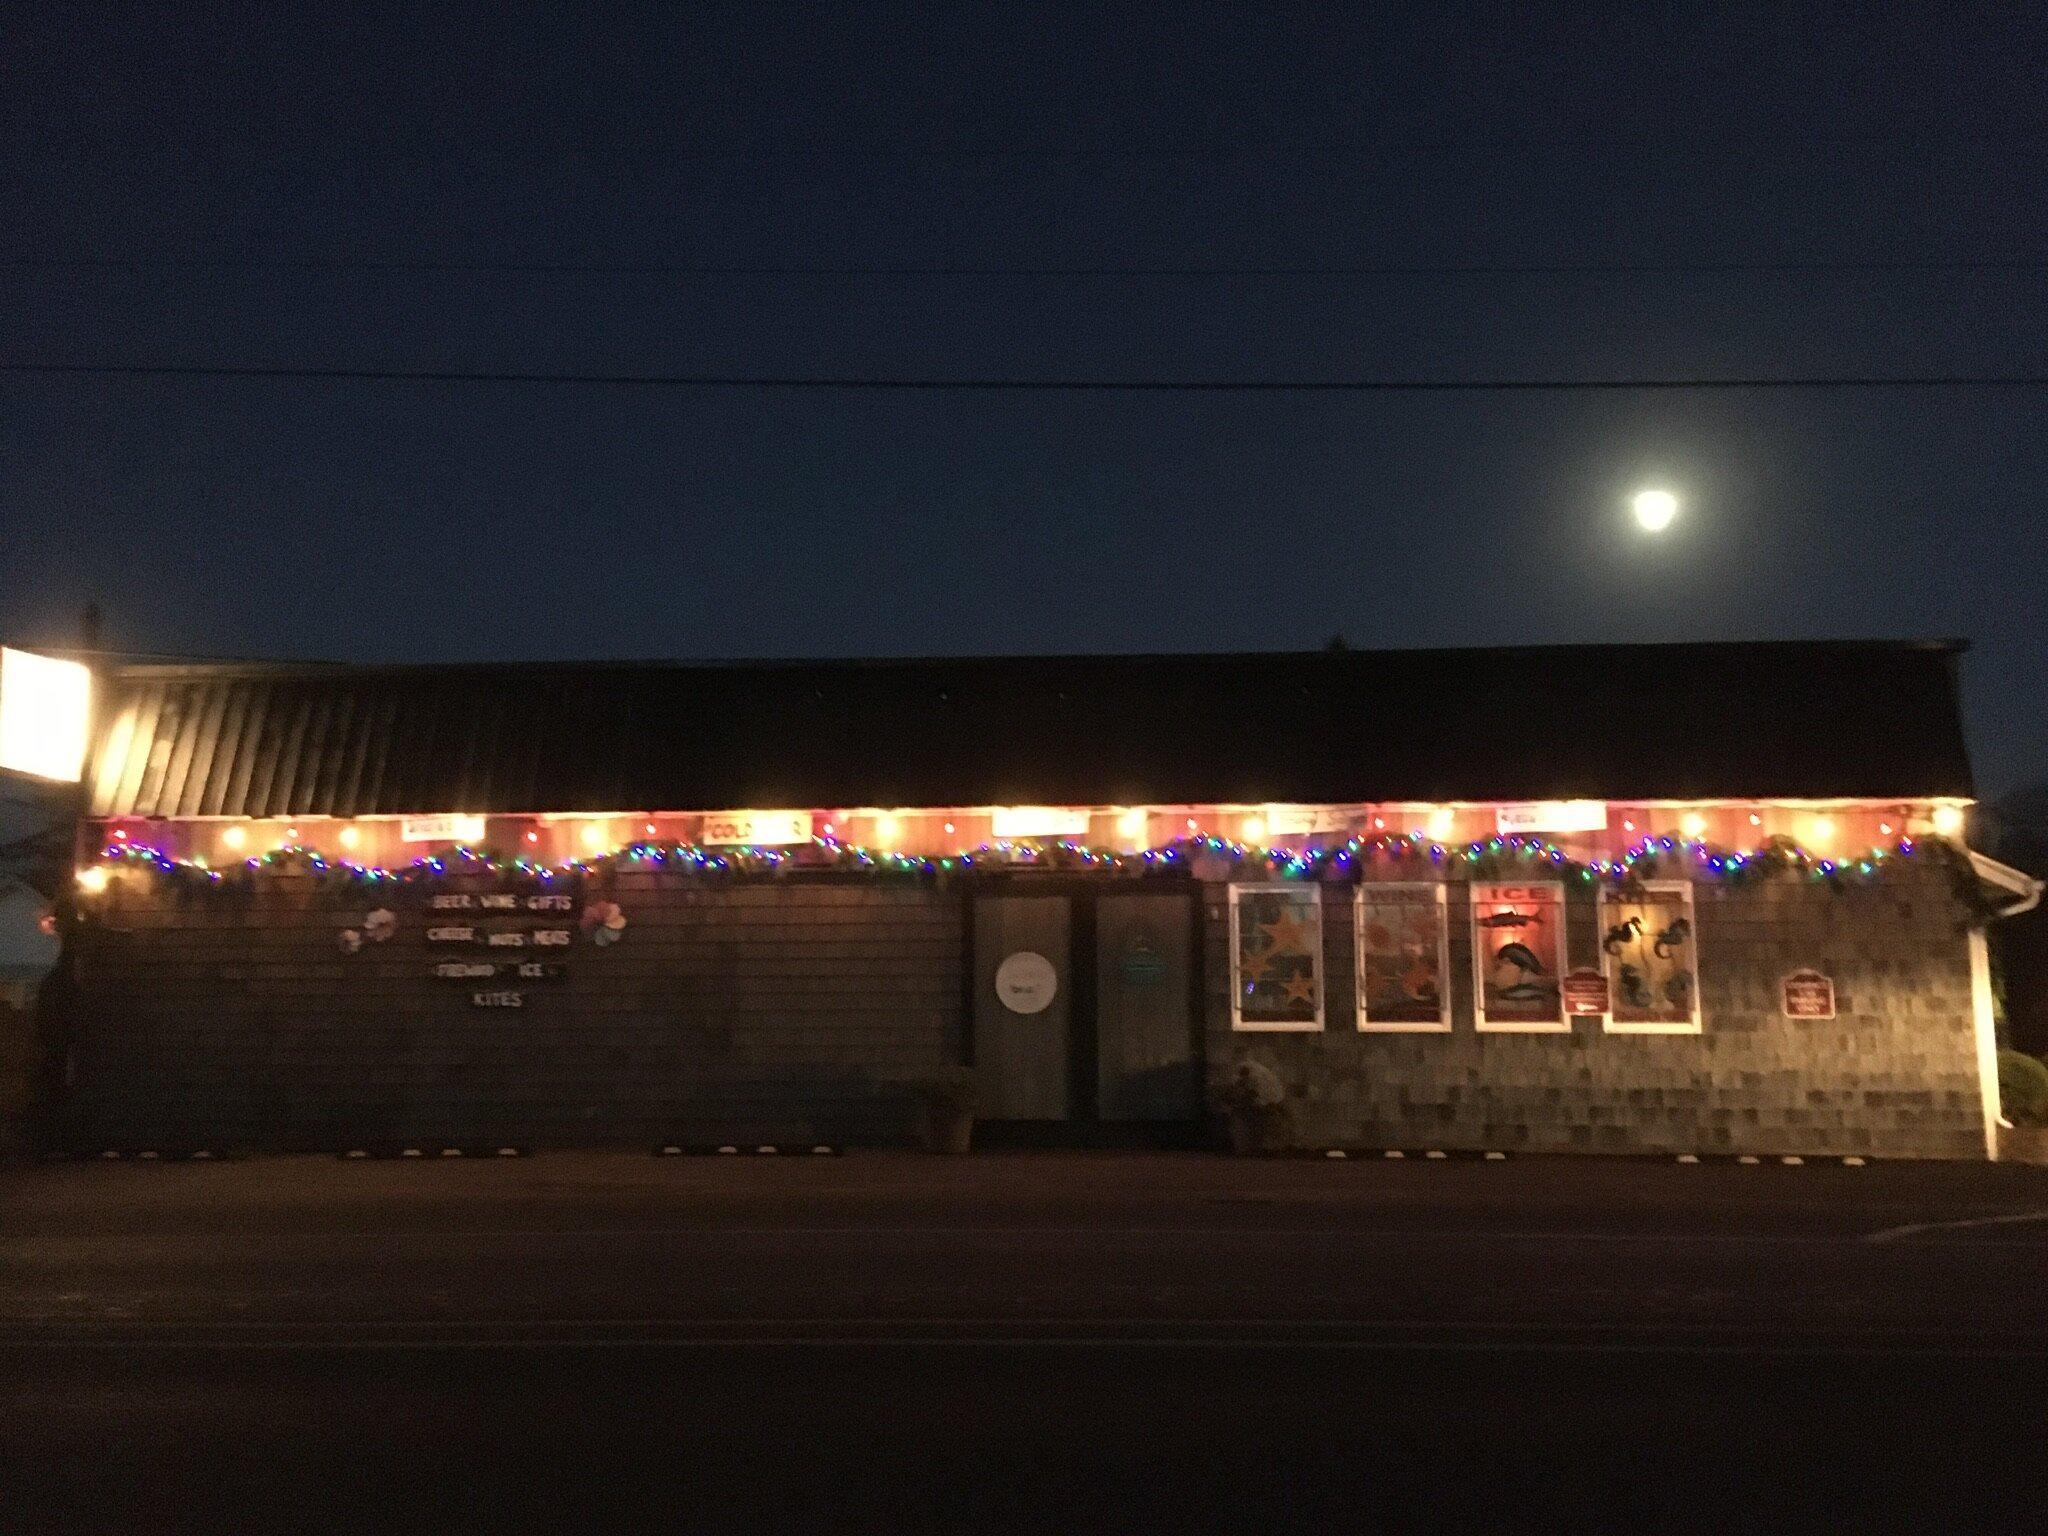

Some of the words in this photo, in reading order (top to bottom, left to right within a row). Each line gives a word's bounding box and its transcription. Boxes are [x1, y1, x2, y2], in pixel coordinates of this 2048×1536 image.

[432, 894, 472, 909] BEER
[480, 893, 517, 909] WINE
[527, 895, 572, 910] GIFTS
[1490, 887, 1548, 901] ICE
[518, 963, 544, 978] ICE
[472, 992, 522, 1008] KITES
